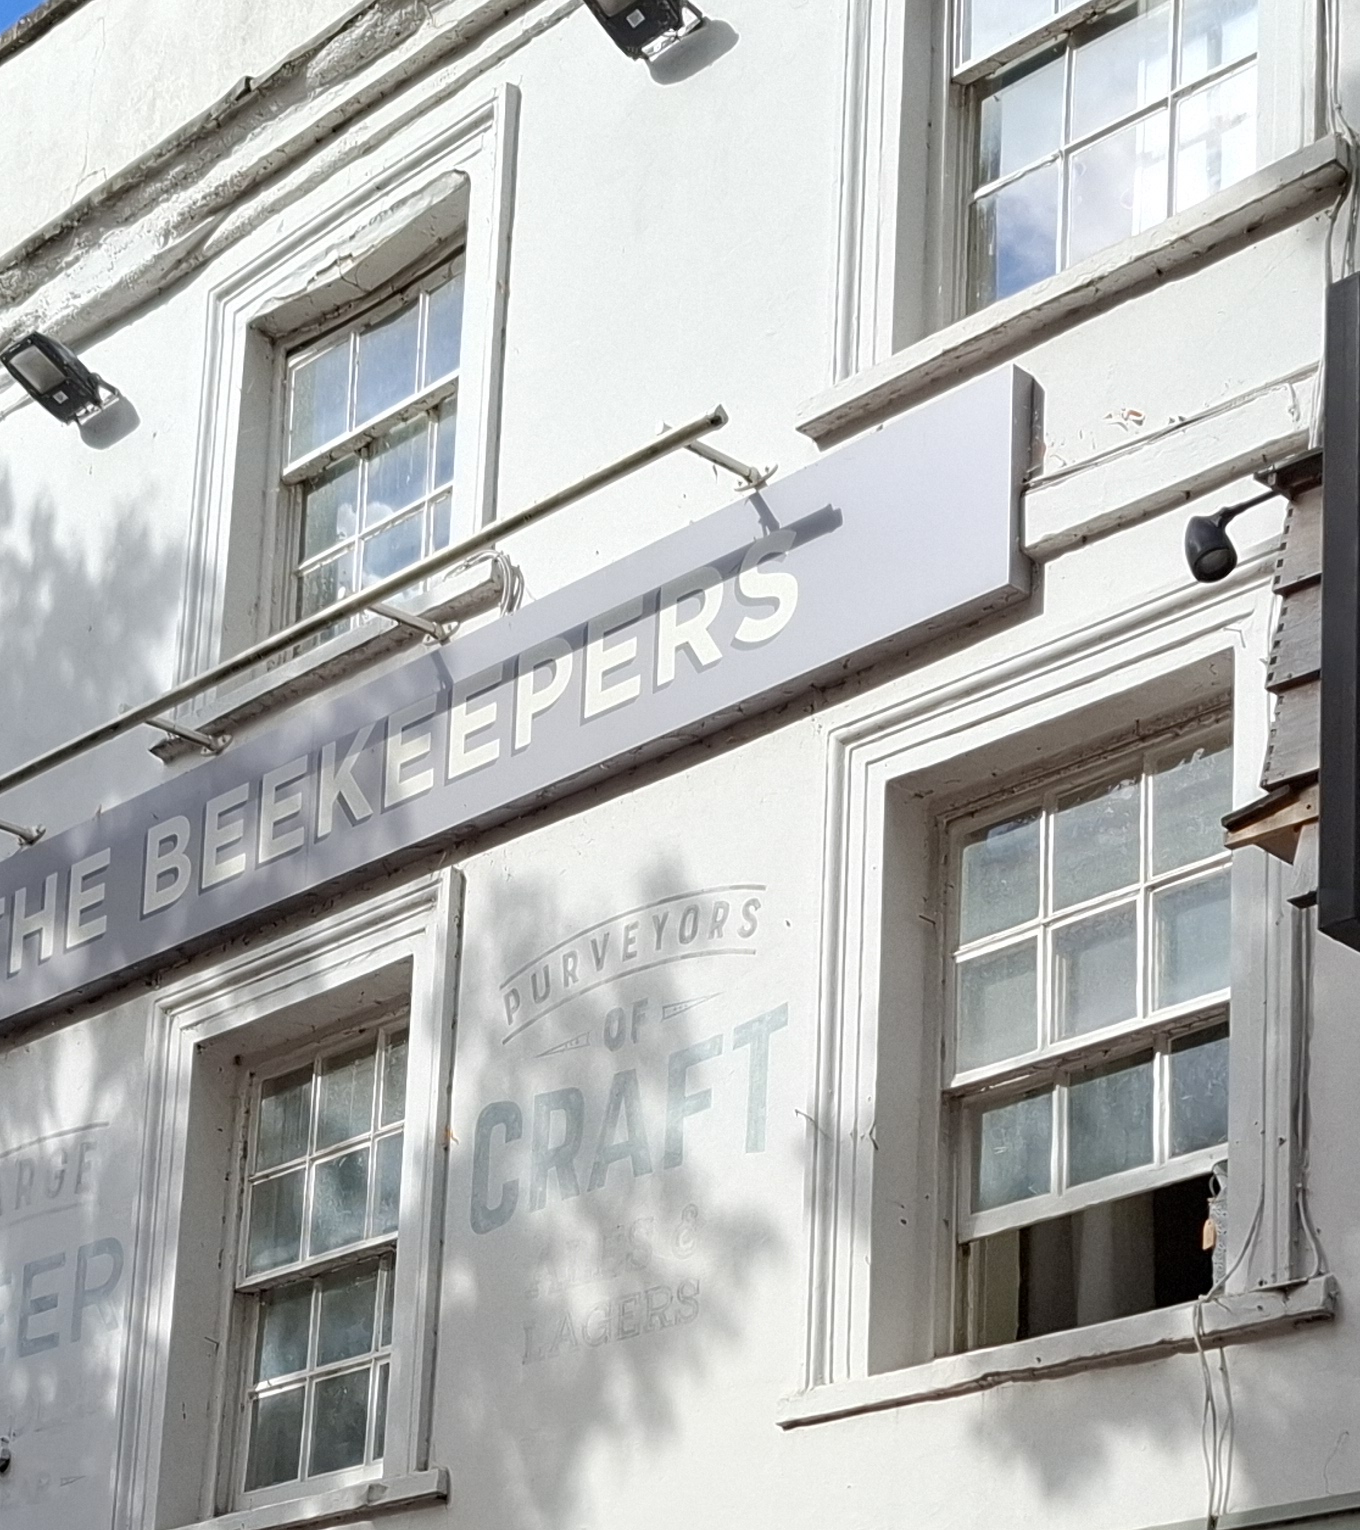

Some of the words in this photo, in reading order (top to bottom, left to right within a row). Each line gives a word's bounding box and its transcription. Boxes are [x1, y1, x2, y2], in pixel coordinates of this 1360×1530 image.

[139, 528, 802, 922] BEEKEEPERS
[503, 897, 763, 1026] PURVEYORS
[603, 997, 649, 1053] OF
[470, 1001, 789, 1236] CRAFT
